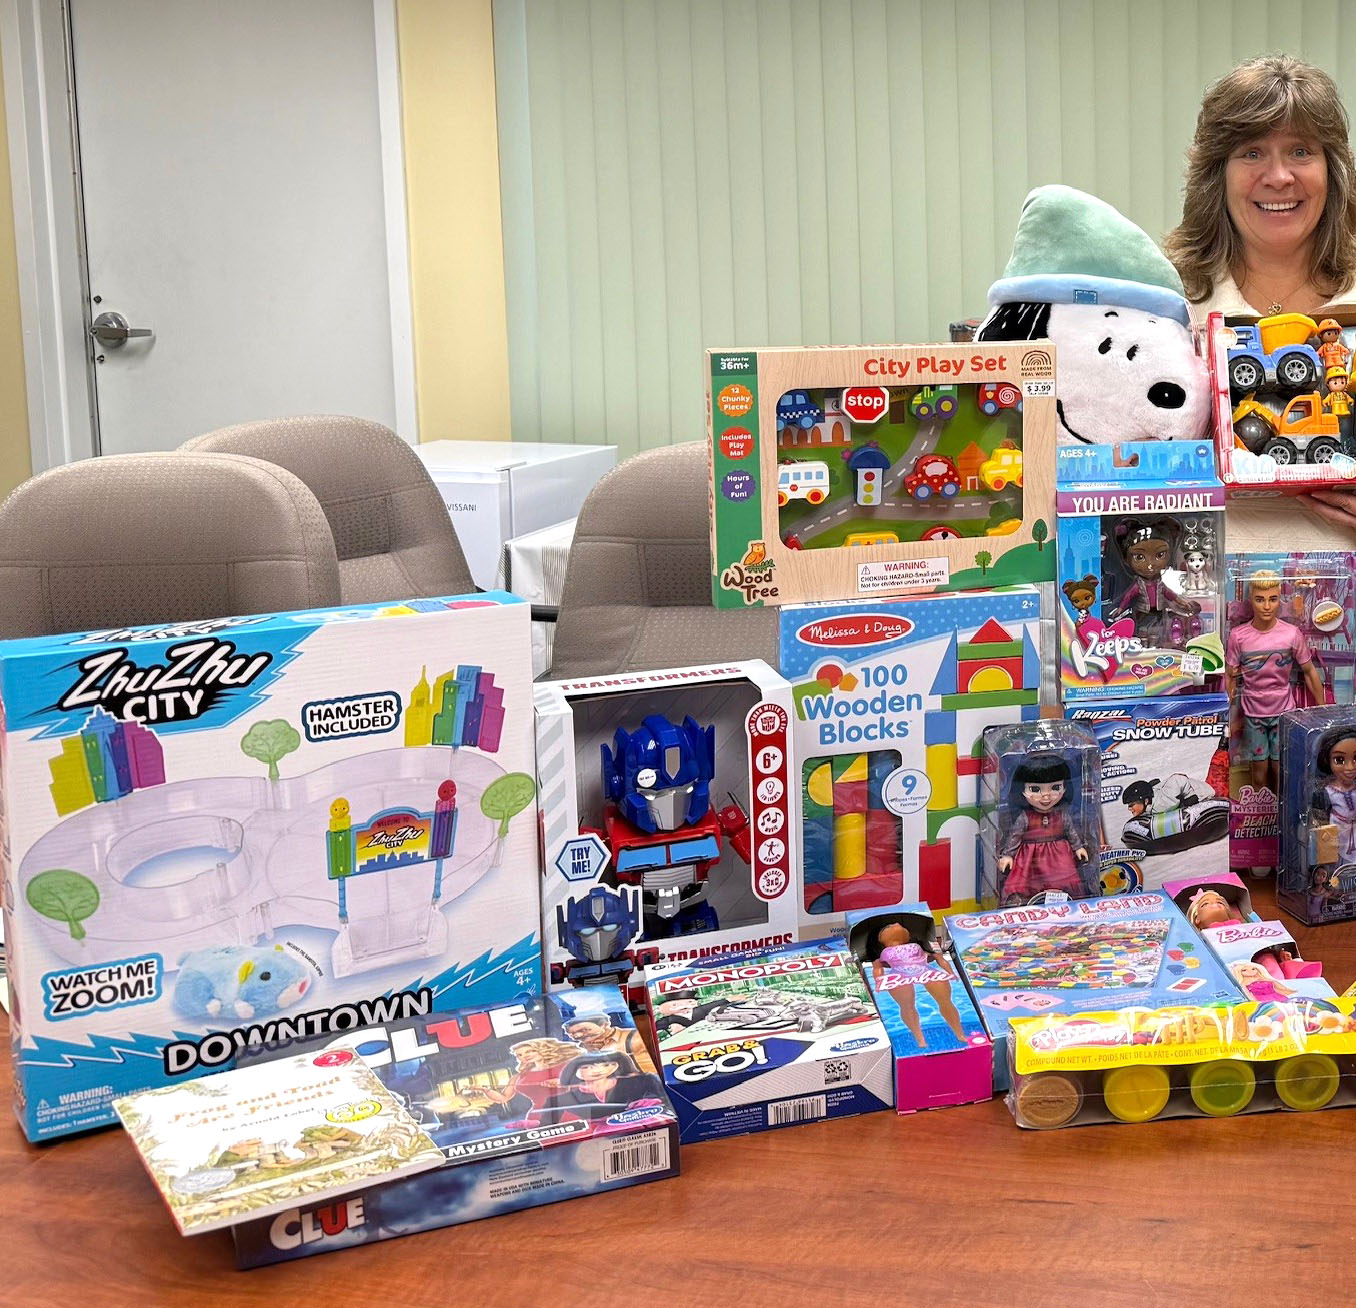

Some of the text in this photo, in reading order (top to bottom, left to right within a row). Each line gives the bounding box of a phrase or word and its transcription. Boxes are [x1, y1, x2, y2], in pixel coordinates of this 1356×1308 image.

[720, 361, 750, 370] 36m+
[864, 355, 1007, 378] City Play Set
[847, 391, 883, 409] stop
[729, 441, 744, 449] Play
[1060, 449, 1096, 458] AGES 4+
[446, 503, 477, 512] VISSANI
[1072, 493, 1213, 513] YOU ARE RADIANT
[724, 566, 772, 586] Wood
[884, 561, 929, 571] WARNING:
[741, 584, 779, 601] Tree
[808, 622, 860, 641] Melissa
[1101, 628, 1115, 638] for
[1070, 631, 1143, 677] Keeps
[63, 641, 269, 708] ZhuZhu
[559, 666, 743, 691] TRANSFORMERS
[861, 664, 908, 688] 100
[123, 689, 204, 722] CITY
[310, 700, 394, 722] HAMSTER
[804, 690, 922, 721] Wooden
[313, 715, 392, 735] INCLUDED
[1136, 714, 1218, 727] Powder Patrol
[819, 720, 909, 745] Blocks
[1113, 724, 1225, 741] SNOW TUBE
[762, 752, 778, 769] 6+
[902, 775, 917, 795] 9
[1239, 785, 1276, 805] Barbie
[1243, 814, 1277, 827] BEACH
[571, 846, 590, 860] TRY
[571, 860, 591, 875] ME!
[956, 894, 1164, 930] CANDY LAND
[1217, 925, 1283, 944] Barbie
[50, 961, 156, 991] WATCH ME
[513, 967, 533, 978] AGES
[517, 976, 531, 985] 4+
[664, 955, 836, 992] MONOPOLY
[879, 972, 955, 991] Barbie
[53, 978, 154, 1013] ZOOM!
[168, 991, 429, 1073] DOWNTOWN
[320, 1004, 532, 1068] CLUE
[672, 1040, 761, 1065] GRAB &
[1026, 1057, 1066, 1067] COMPOUND
[1067, 1056, 1080, 1064] NET
[1098, 1053, 1118, 1062] POIDS
[1174, 1049, 1193, 1057] CONT.
[674, 1044, 769, 1082] GO!
[59, 1085, 113, 1105] WARNING:
[448, 1124, 575, 1157] Mystery Game
[269, 1198, 366, 1251] CLUE
